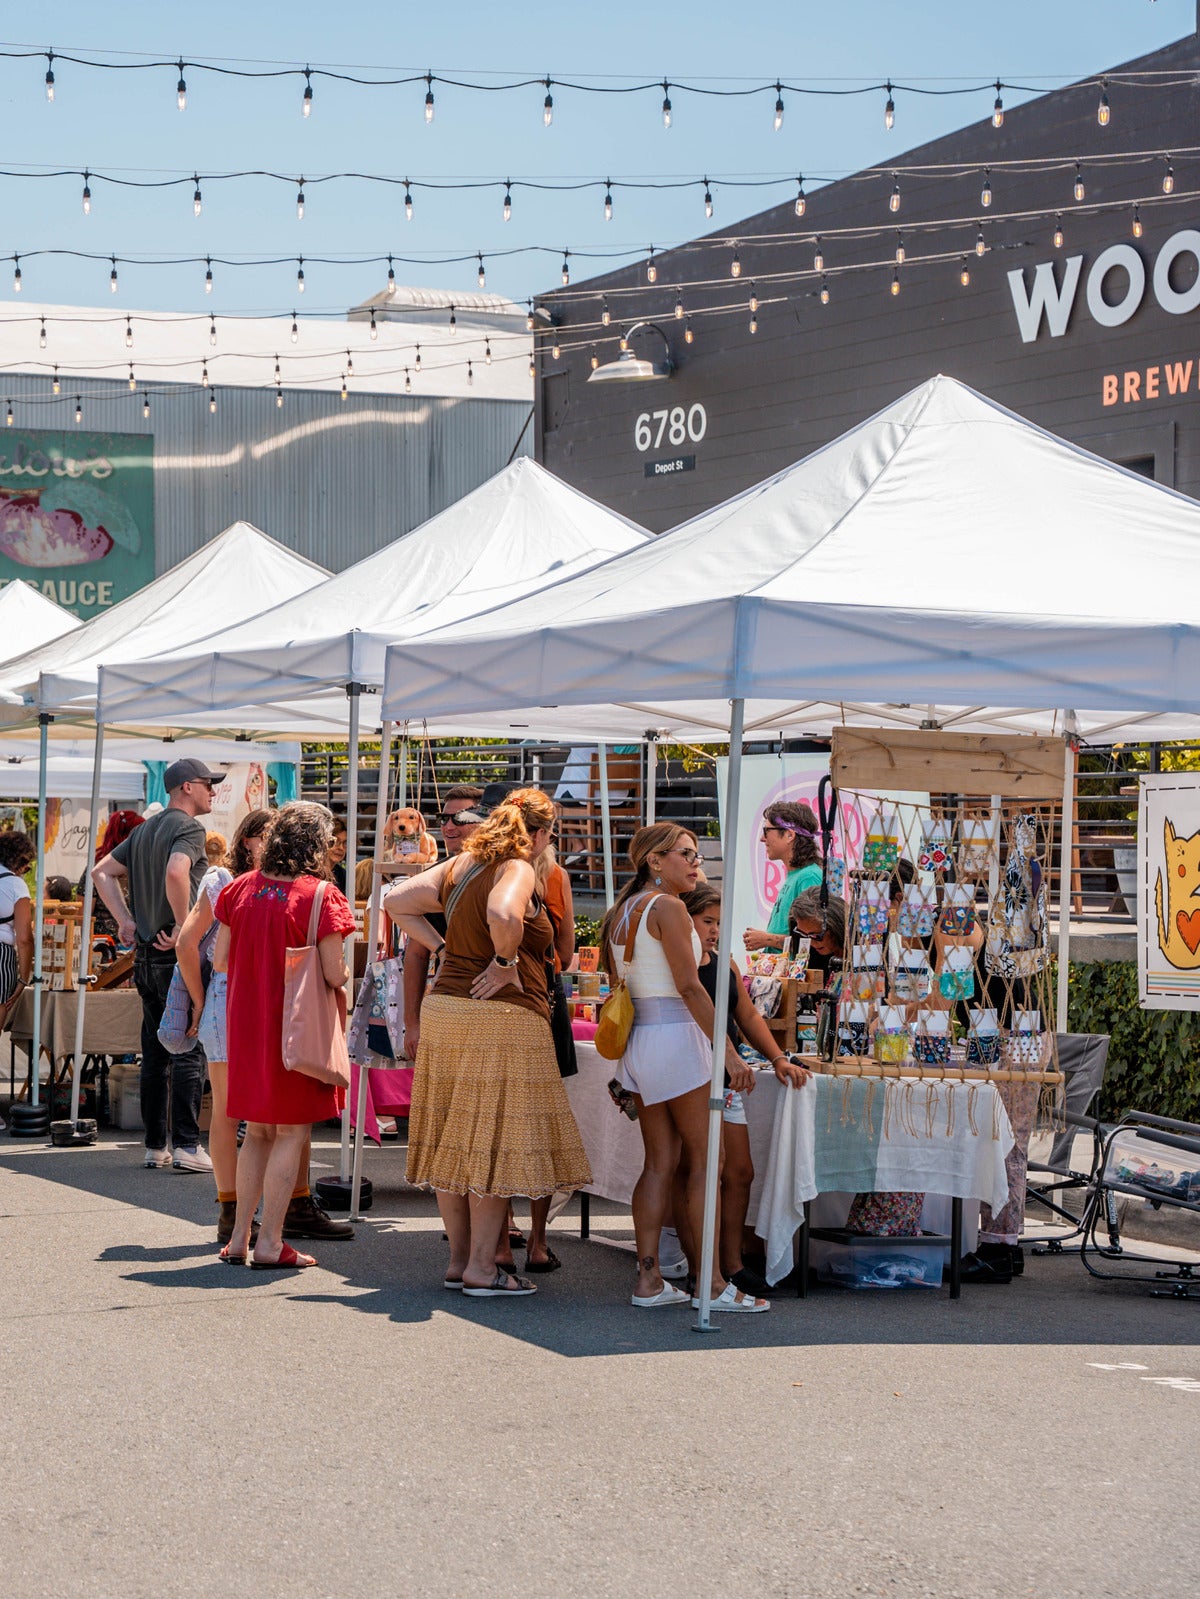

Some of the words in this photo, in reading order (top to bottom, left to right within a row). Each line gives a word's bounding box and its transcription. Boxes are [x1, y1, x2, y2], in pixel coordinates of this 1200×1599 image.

[1007, 229, 1200, 343] WOO
[1103, 359, 1200, 406] BREW
[635, 403, 707, 451] 6780
[655, 463, 675, 474] Depot
[676, 460, 684, 470] St
